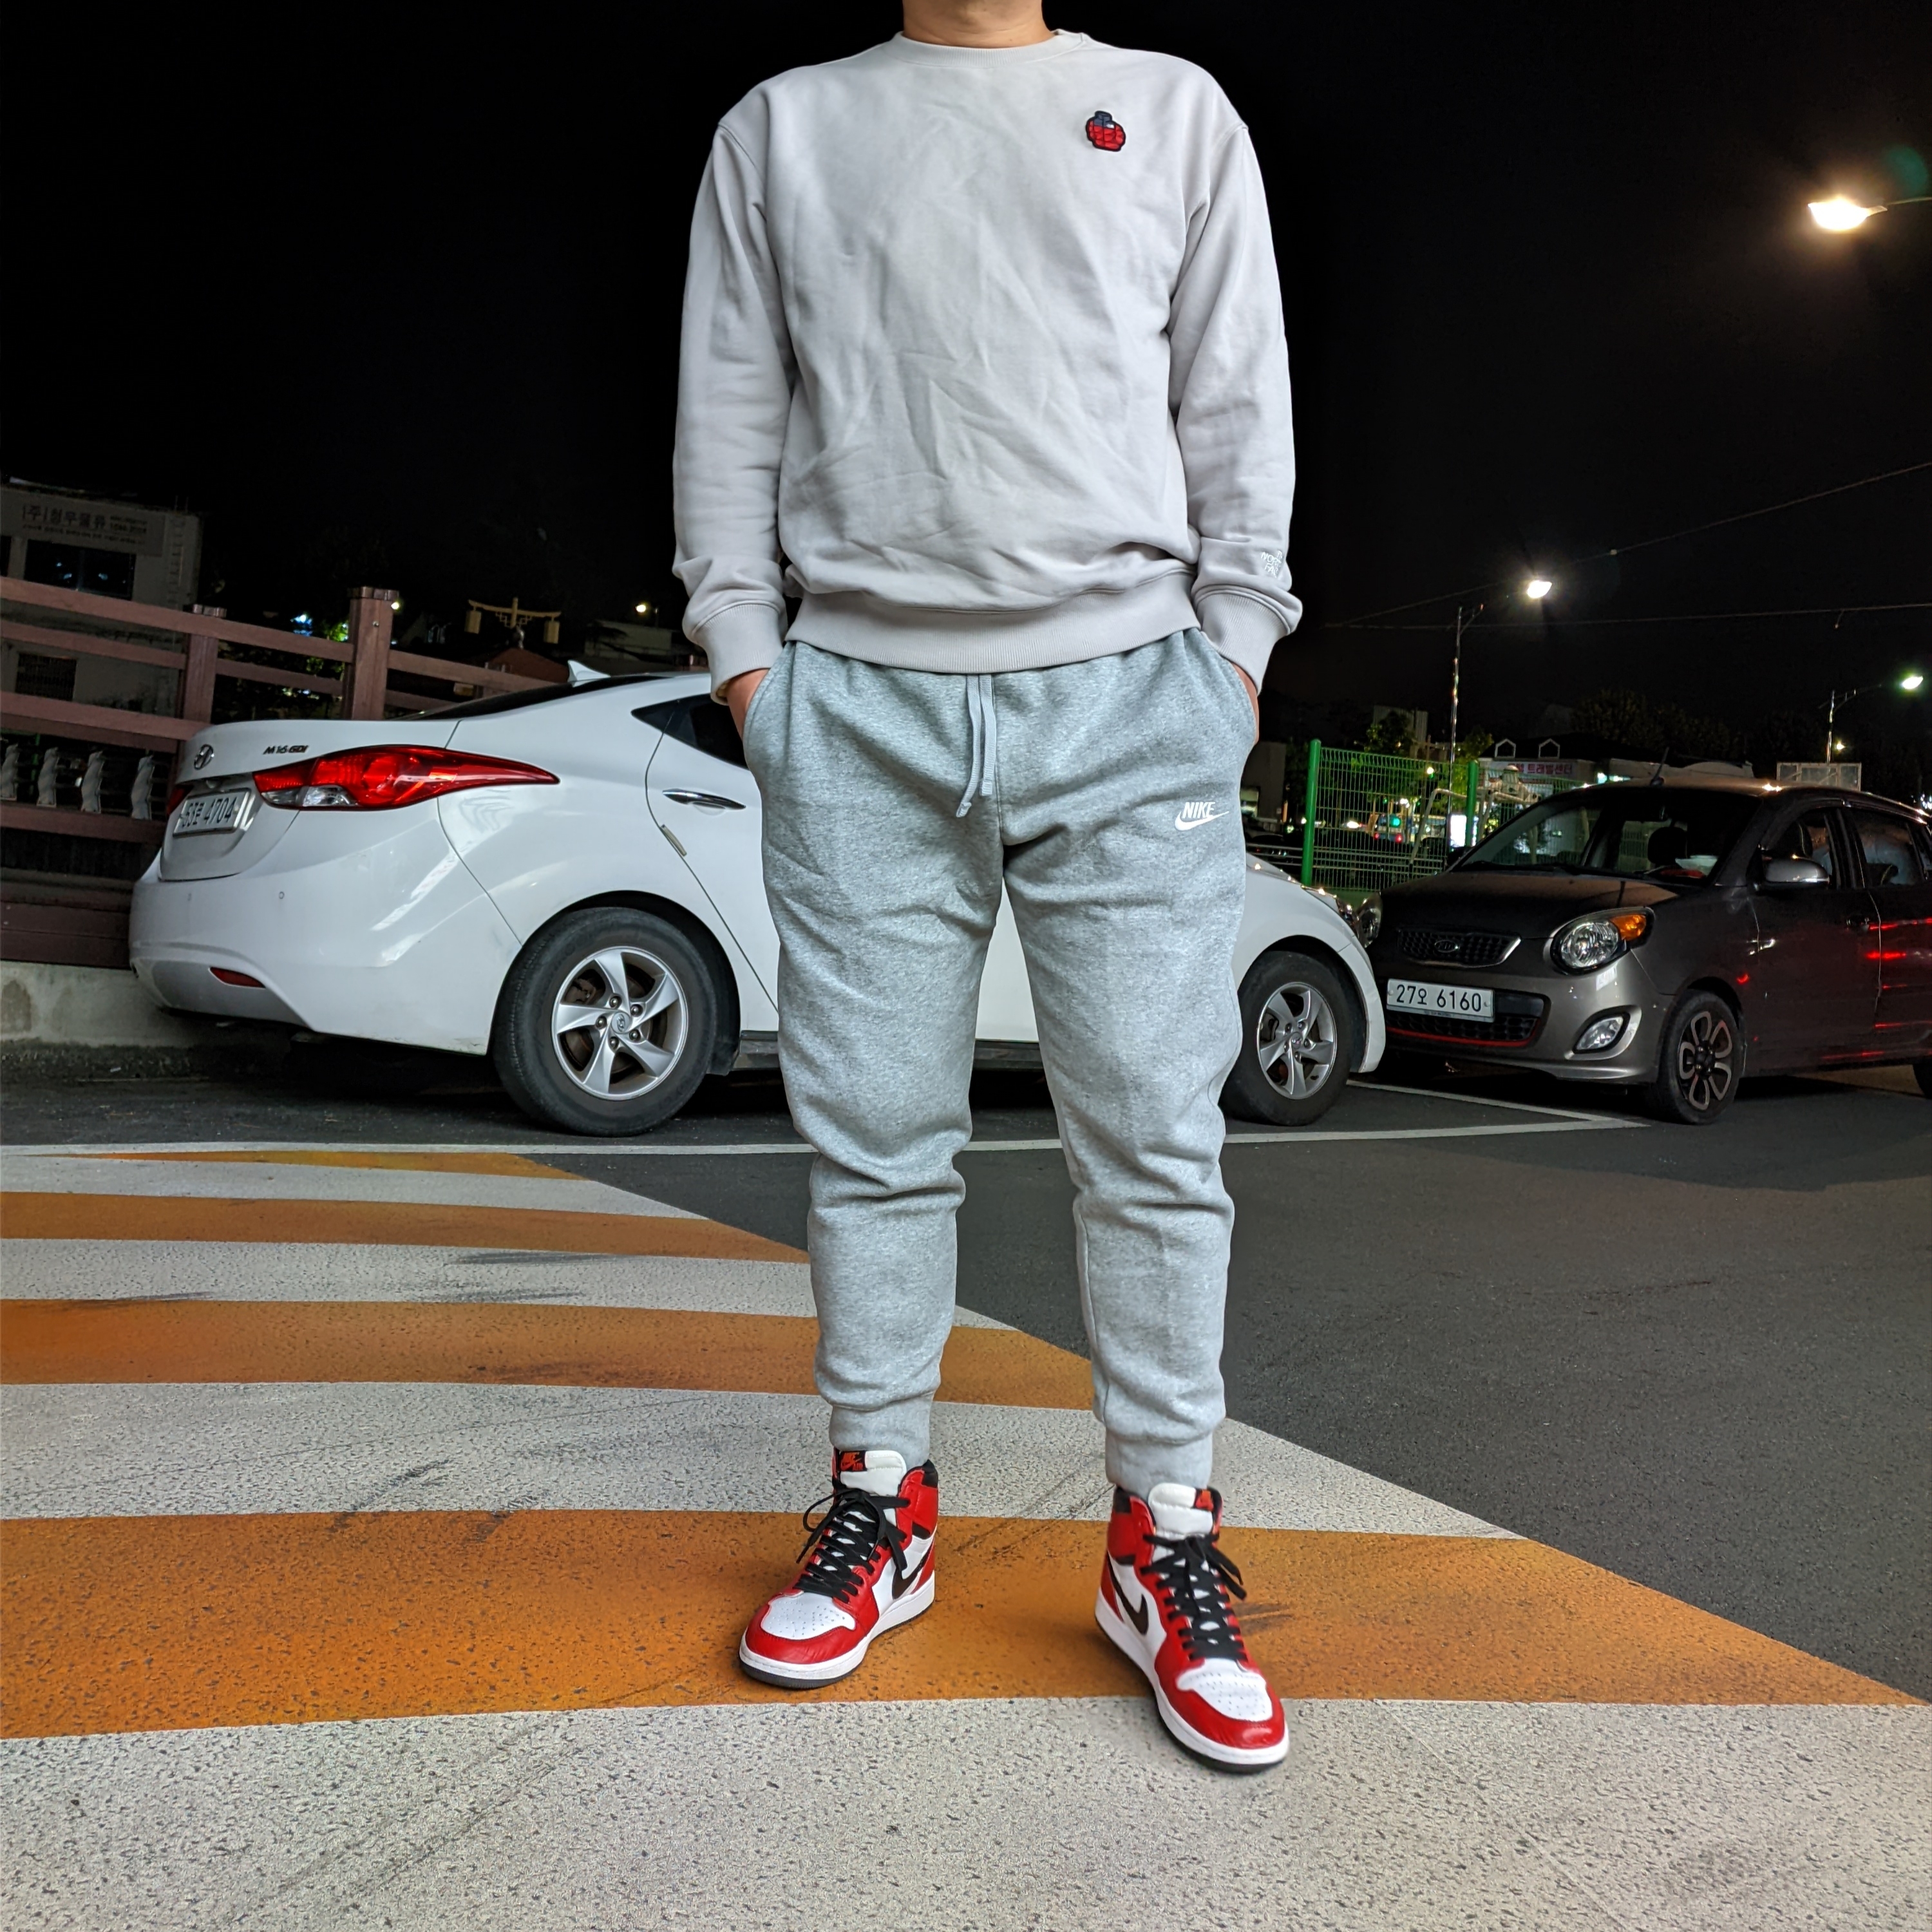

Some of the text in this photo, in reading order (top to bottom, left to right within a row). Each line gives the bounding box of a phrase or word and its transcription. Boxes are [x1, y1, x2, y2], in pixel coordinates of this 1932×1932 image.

[204, 796, 237, 824] 4704
[1182, 801, 1216, 819] NIKE
[1396, 983, 1482, 1012] 27오 6160
